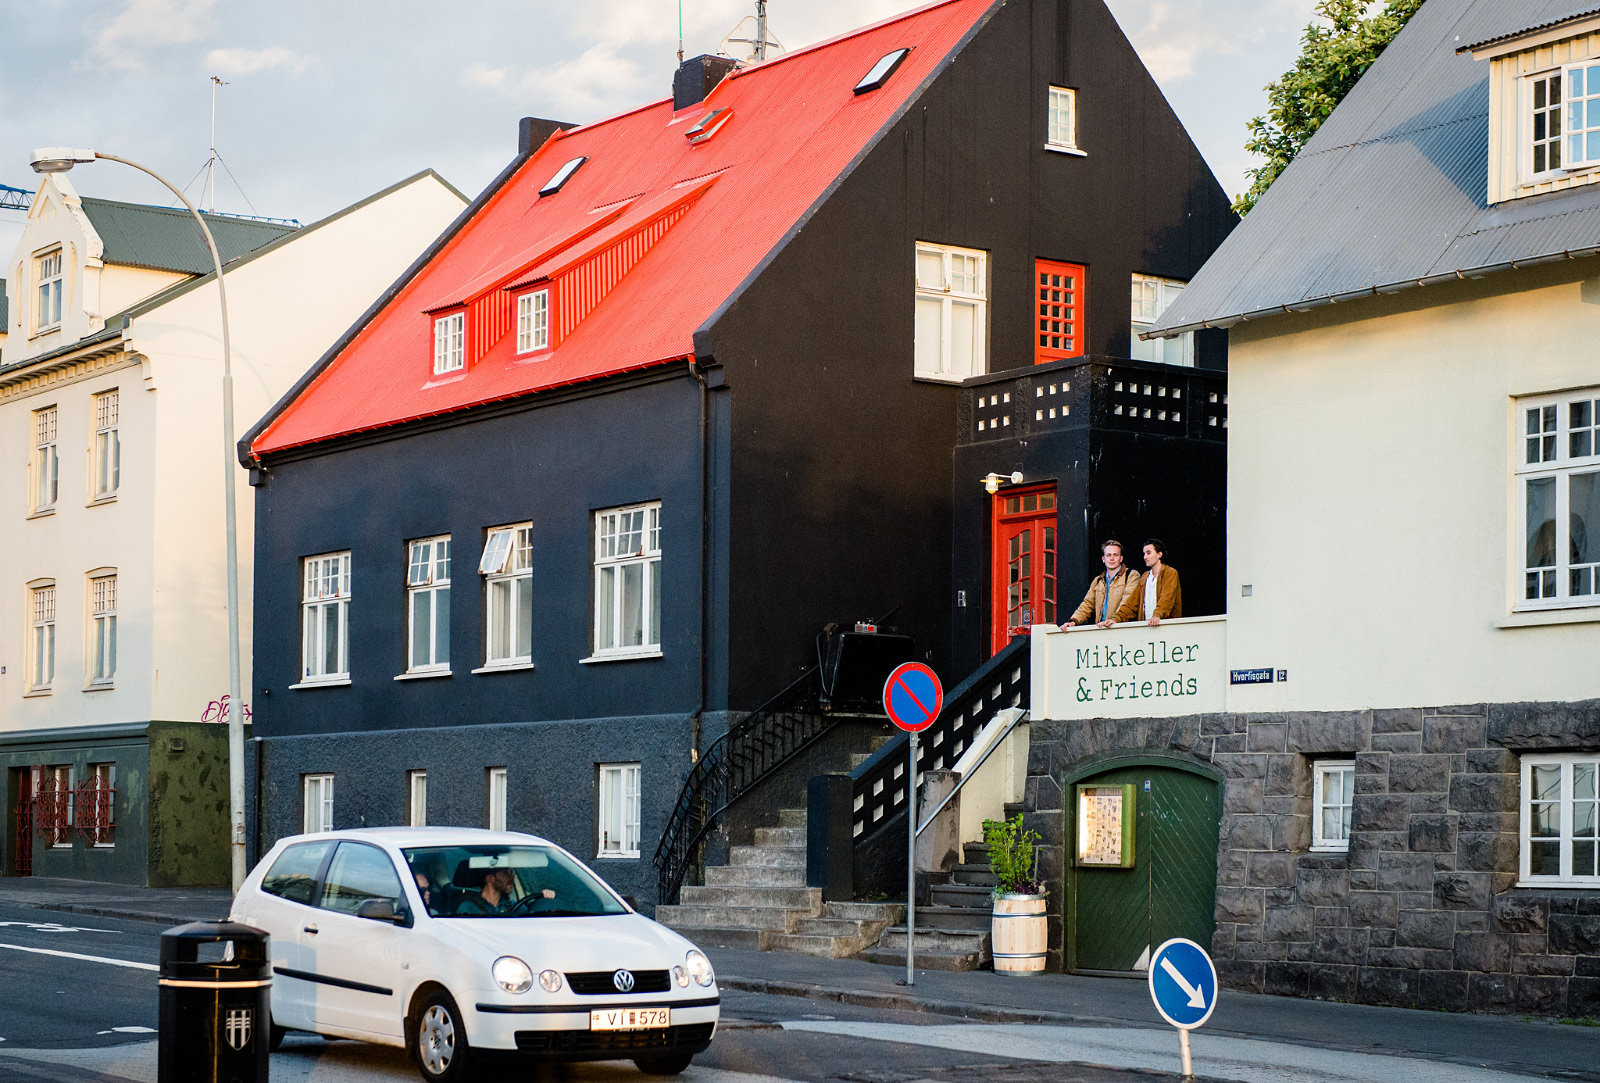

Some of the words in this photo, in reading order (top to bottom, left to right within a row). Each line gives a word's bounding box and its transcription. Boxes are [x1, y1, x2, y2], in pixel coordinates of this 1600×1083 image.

[1075, 640, 1199, 669] Mikkeller
[1232, 670, 1270, 682] Hverfisgata
[1076, 676, 1093, 703] &
[1100, 673, 1198, 700] Friends
[639, 1010, 667, 1025] 578
